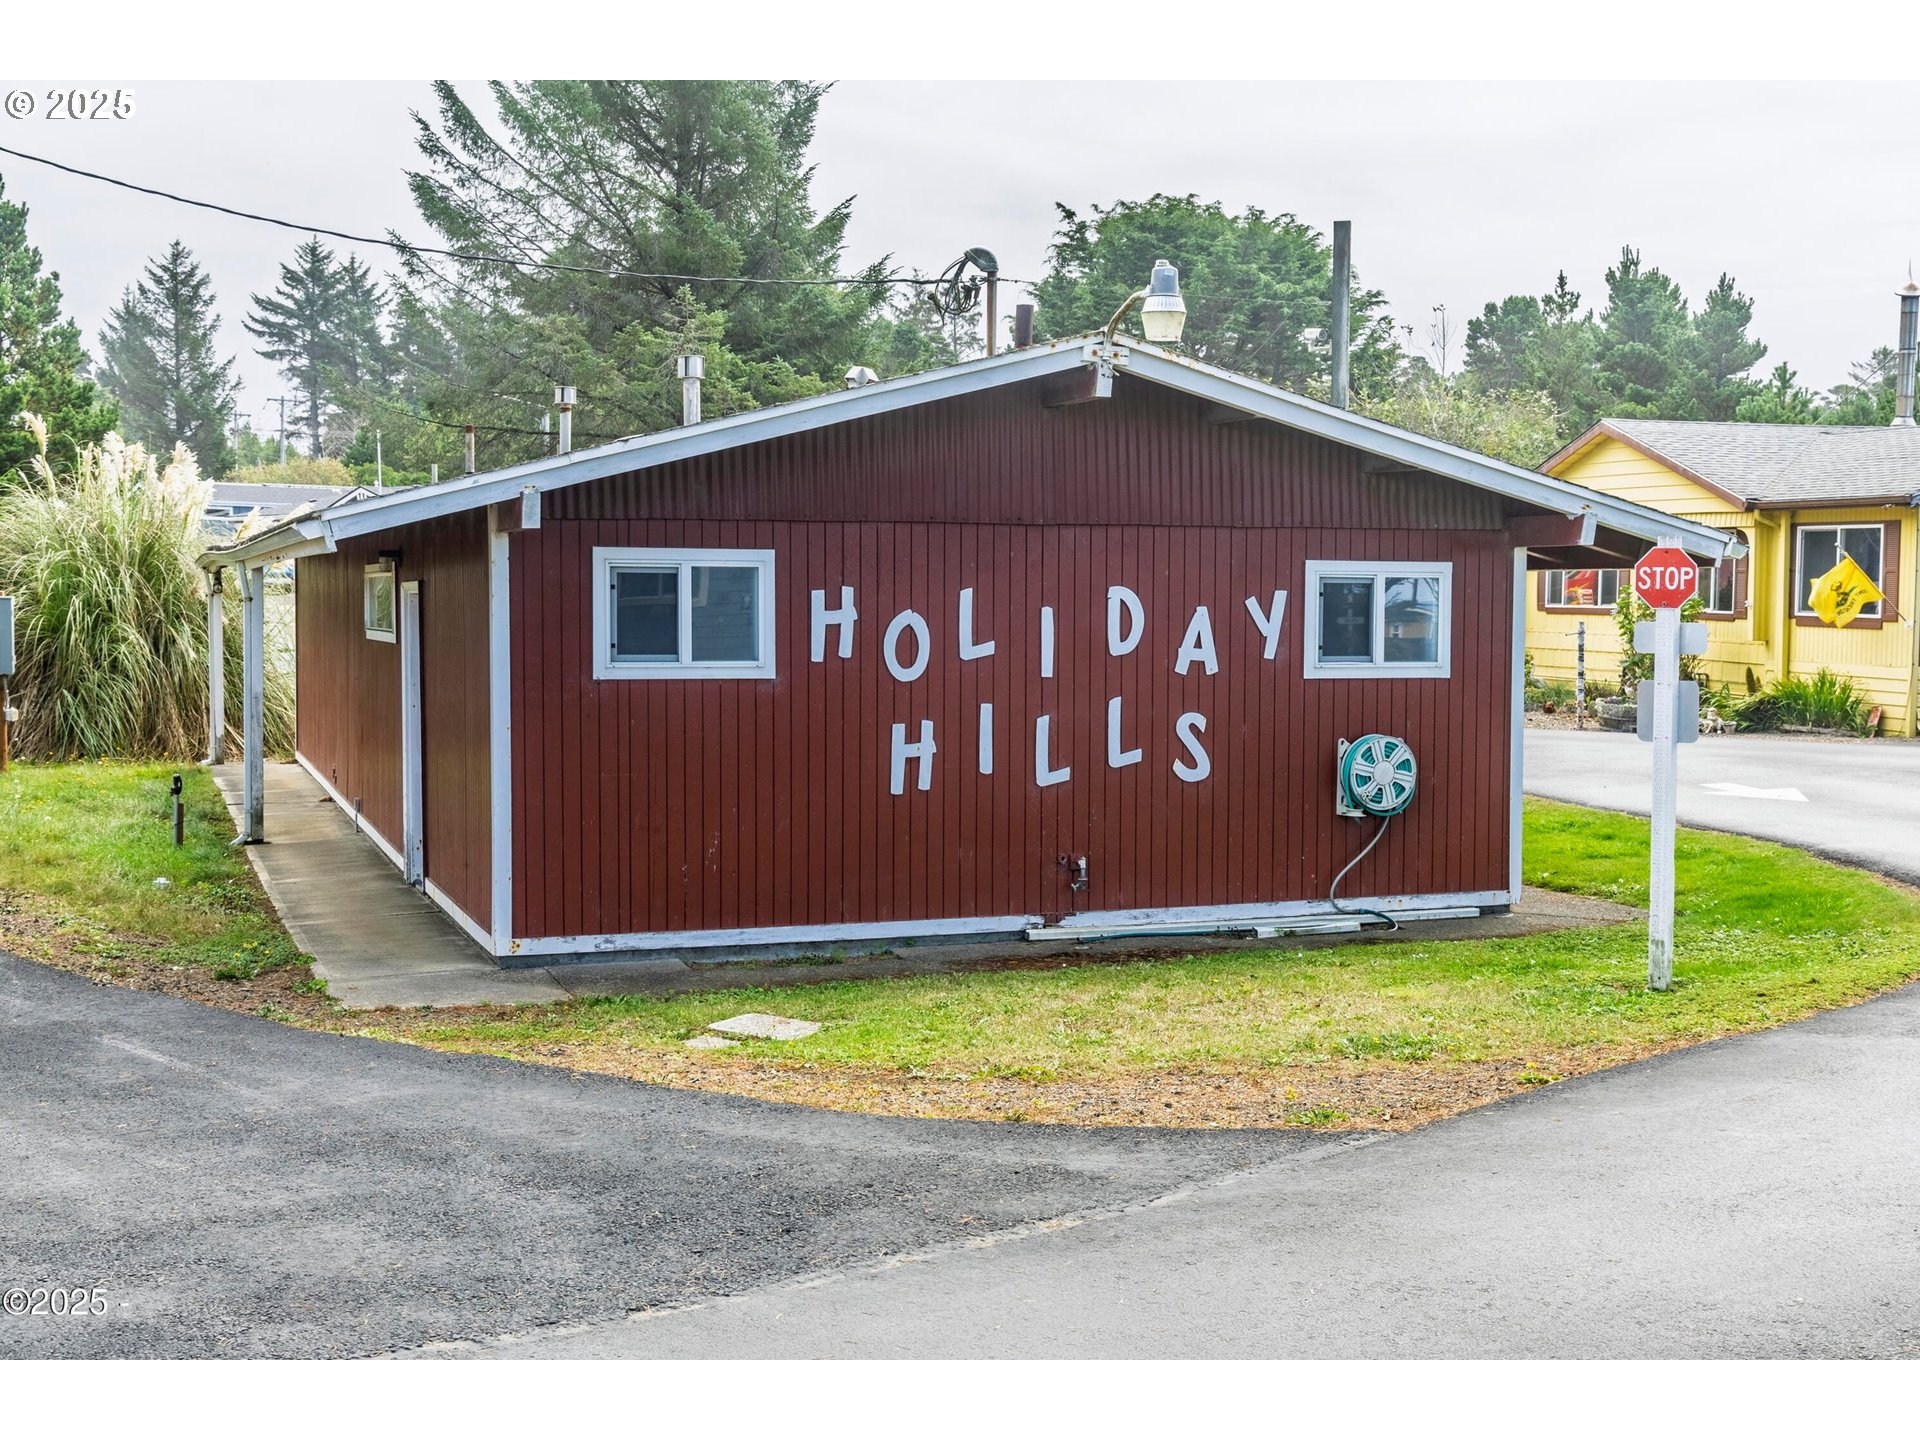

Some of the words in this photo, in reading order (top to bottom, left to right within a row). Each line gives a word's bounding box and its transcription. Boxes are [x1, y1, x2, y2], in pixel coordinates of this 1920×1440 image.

[1638, 566, 1694, 591] STOP
[810, 585, 1288, 683] HOLIDAY
[889, 696, 1211, 796] HILLS
